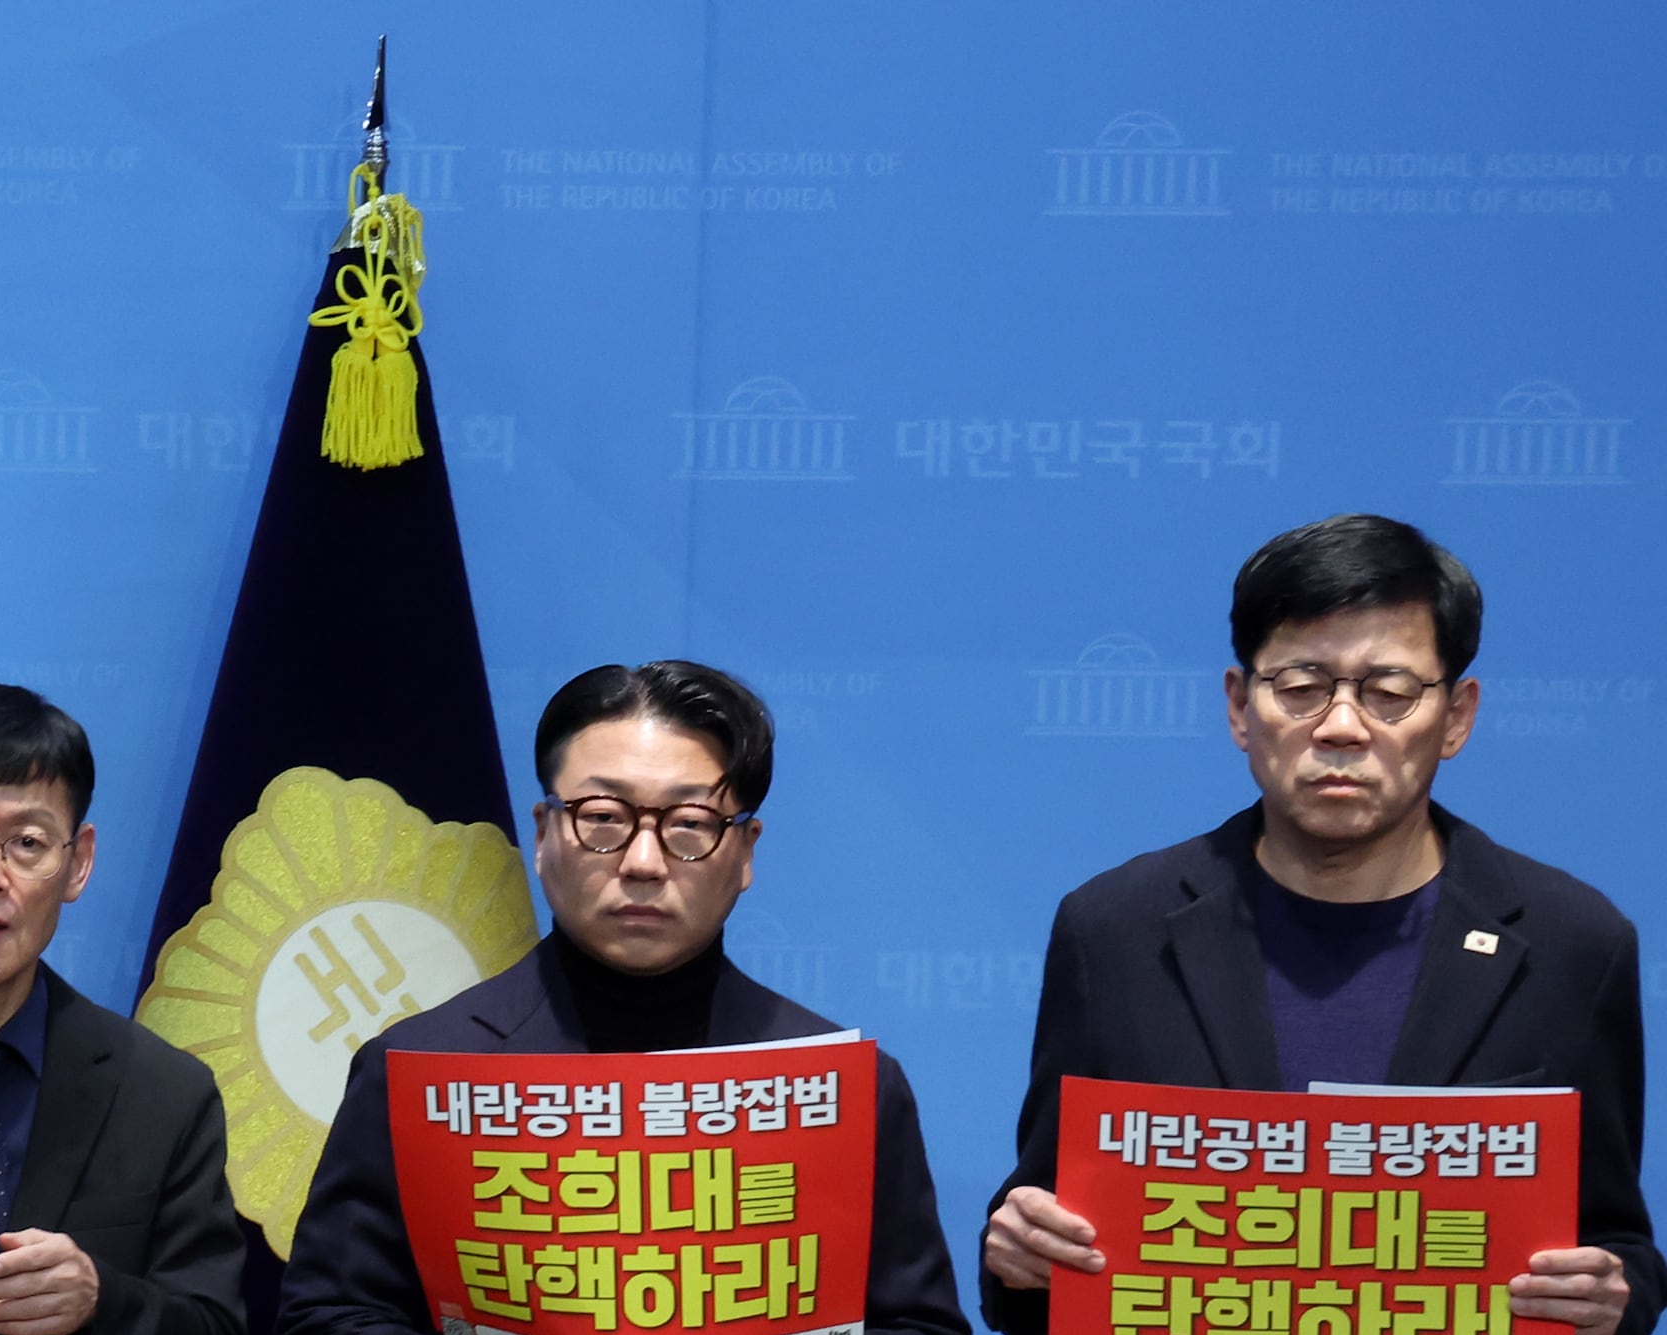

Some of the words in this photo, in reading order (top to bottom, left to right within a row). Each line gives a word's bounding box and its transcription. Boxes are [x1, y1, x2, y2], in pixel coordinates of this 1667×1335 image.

[501, 148, 553, 174] THE
[561, 148, 701, 174] NATIONAL
[709, 149, 856, 175] ASSEMBLY
[864, 149, 902, 175] OF
[1268, 152, 1322, 178] THE
[1330, 152, 1473, 178] NATIONAL
[1481, 152, 1632, 178] ASSEMBLY
[1640, 152, 1667, 178] O
[501, 184, 552, 210] THE
[560, 184, 690, 211] REPUBLIC
[703, 185, 735, 211] OF
[743, 185, 836, 212] KOREA
[1268, 187, 1321, 213] THE
[1329, 187, 1460, 213] REPUBLIC
[1468, 187, 1508, 213] OF
[1516, 187, 1614, 214] KOREA
[895, 417, 1283, 480] 대한민국국회
[425, 1081, 622, 1137] 내란공범
[639, 1071, 839, 1137] 불량잡범
[1098, 1110, 1307, 1174] 내란공범
[1324, 1120, 1537, 1178] 불량잡범
[472, 1148, 796, 1234] 조희대를
[1140, 1182, 1487, 1271] 조희대를
[455, 1234, 819, 1330] 탄핵하라!
